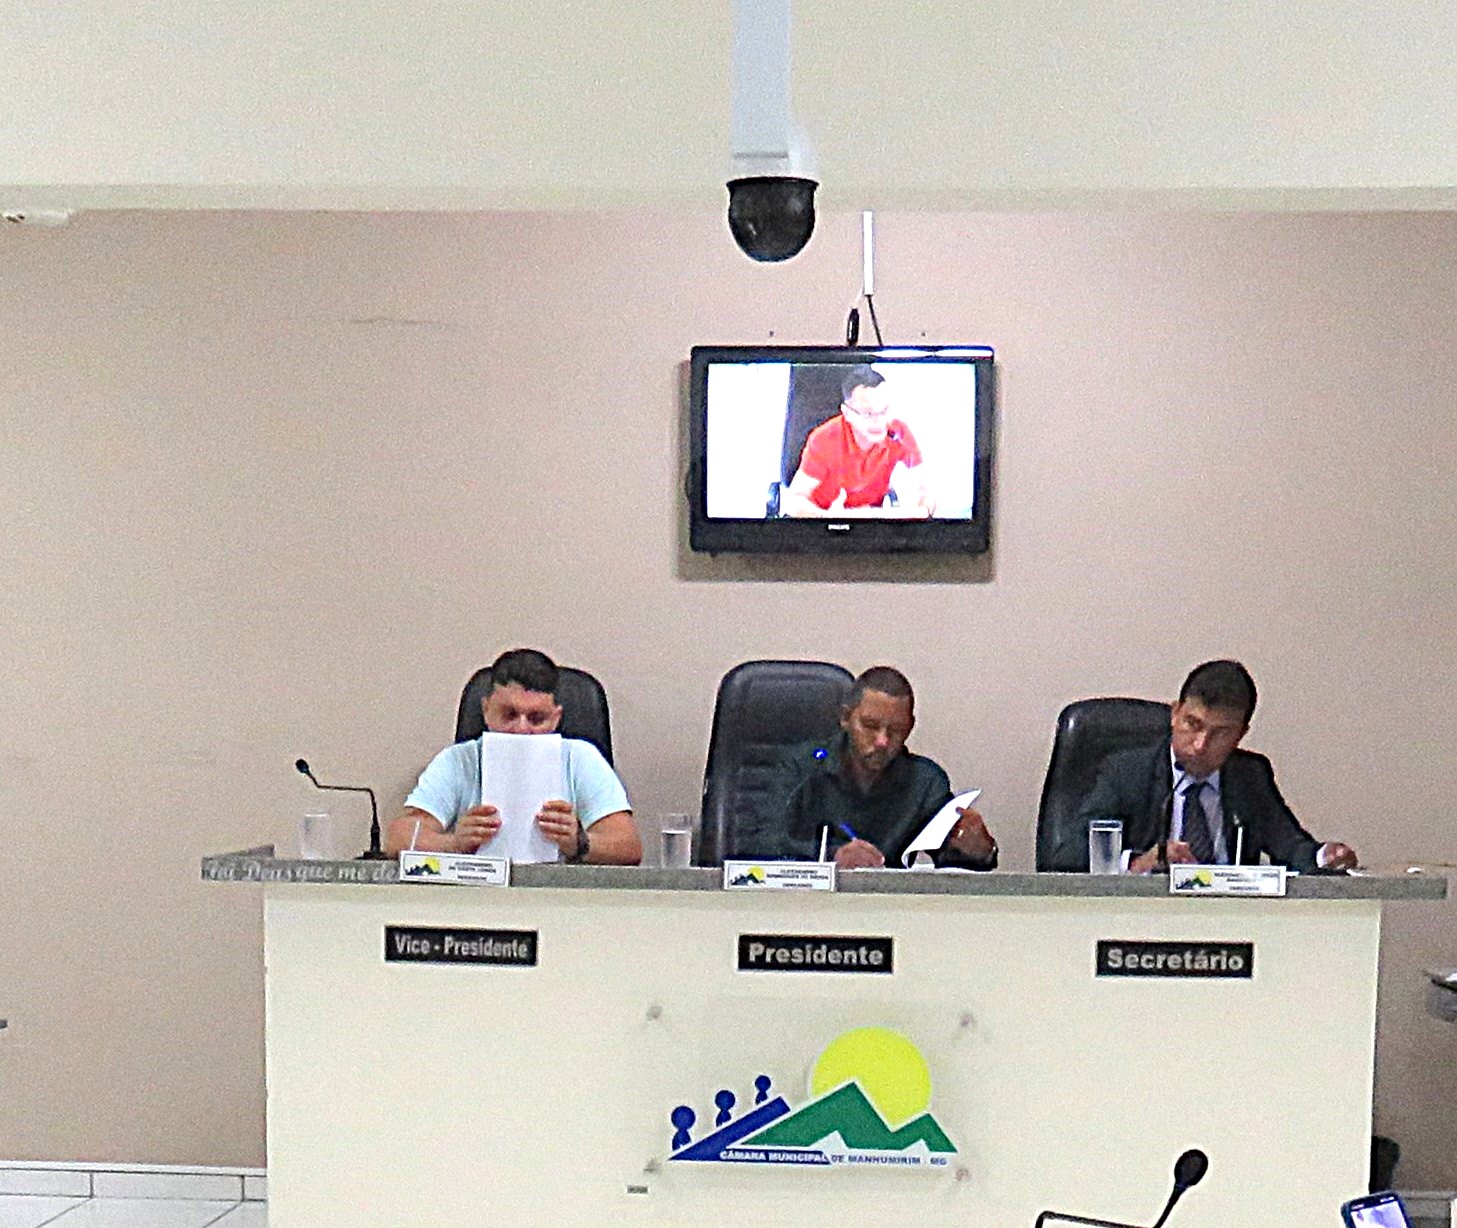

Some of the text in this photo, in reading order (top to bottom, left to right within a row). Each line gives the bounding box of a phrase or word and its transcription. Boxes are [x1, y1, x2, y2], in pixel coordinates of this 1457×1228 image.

[338, 866, 367, 880] me
[394, 933, 431, 954] Vice
[443, 935, 529, 959] Presidente
[748, 942, 884, 966] Presidente
[1106, 947, 1244, 971] Secretário
[768, 1151, 827, 1162] MUNICIPAL
